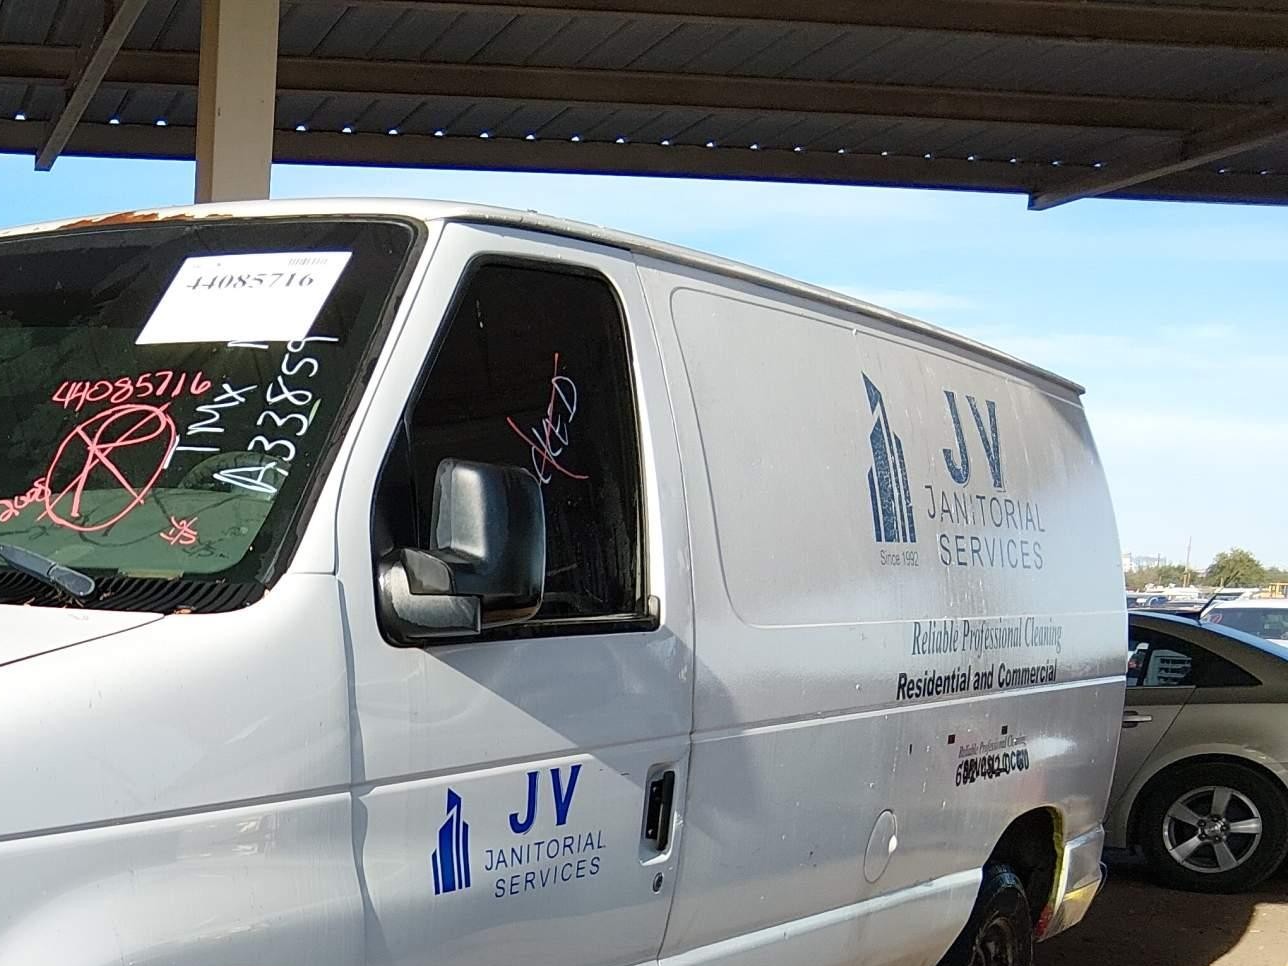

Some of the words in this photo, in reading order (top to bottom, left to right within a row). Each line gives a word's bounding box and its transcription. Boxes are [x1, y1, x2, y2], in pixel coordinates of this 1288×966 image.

[186, 272, 315, 290] 44085716
[52, 371, 212, 412] 44085716
[942, 390, 1003, 489] JV
[924, 485, 1046, 532] JANITORIAL
[939, 534, 1044, 570] SERVICES
[911, 620, 959, 655] Reliable
[961, 617, 1022, 658] Professional
[1024, 616, 1063, 654] Cleaning
[896, 665, 972, 700] Residential
[972, 663, 995, 690] and
[997, 658, 1058, 687] Commercial
[508, 764, 583, 834] JV
[484, 830, 607, 872] JANITORIAL
[494, 856, 601, 899] SERVICES
